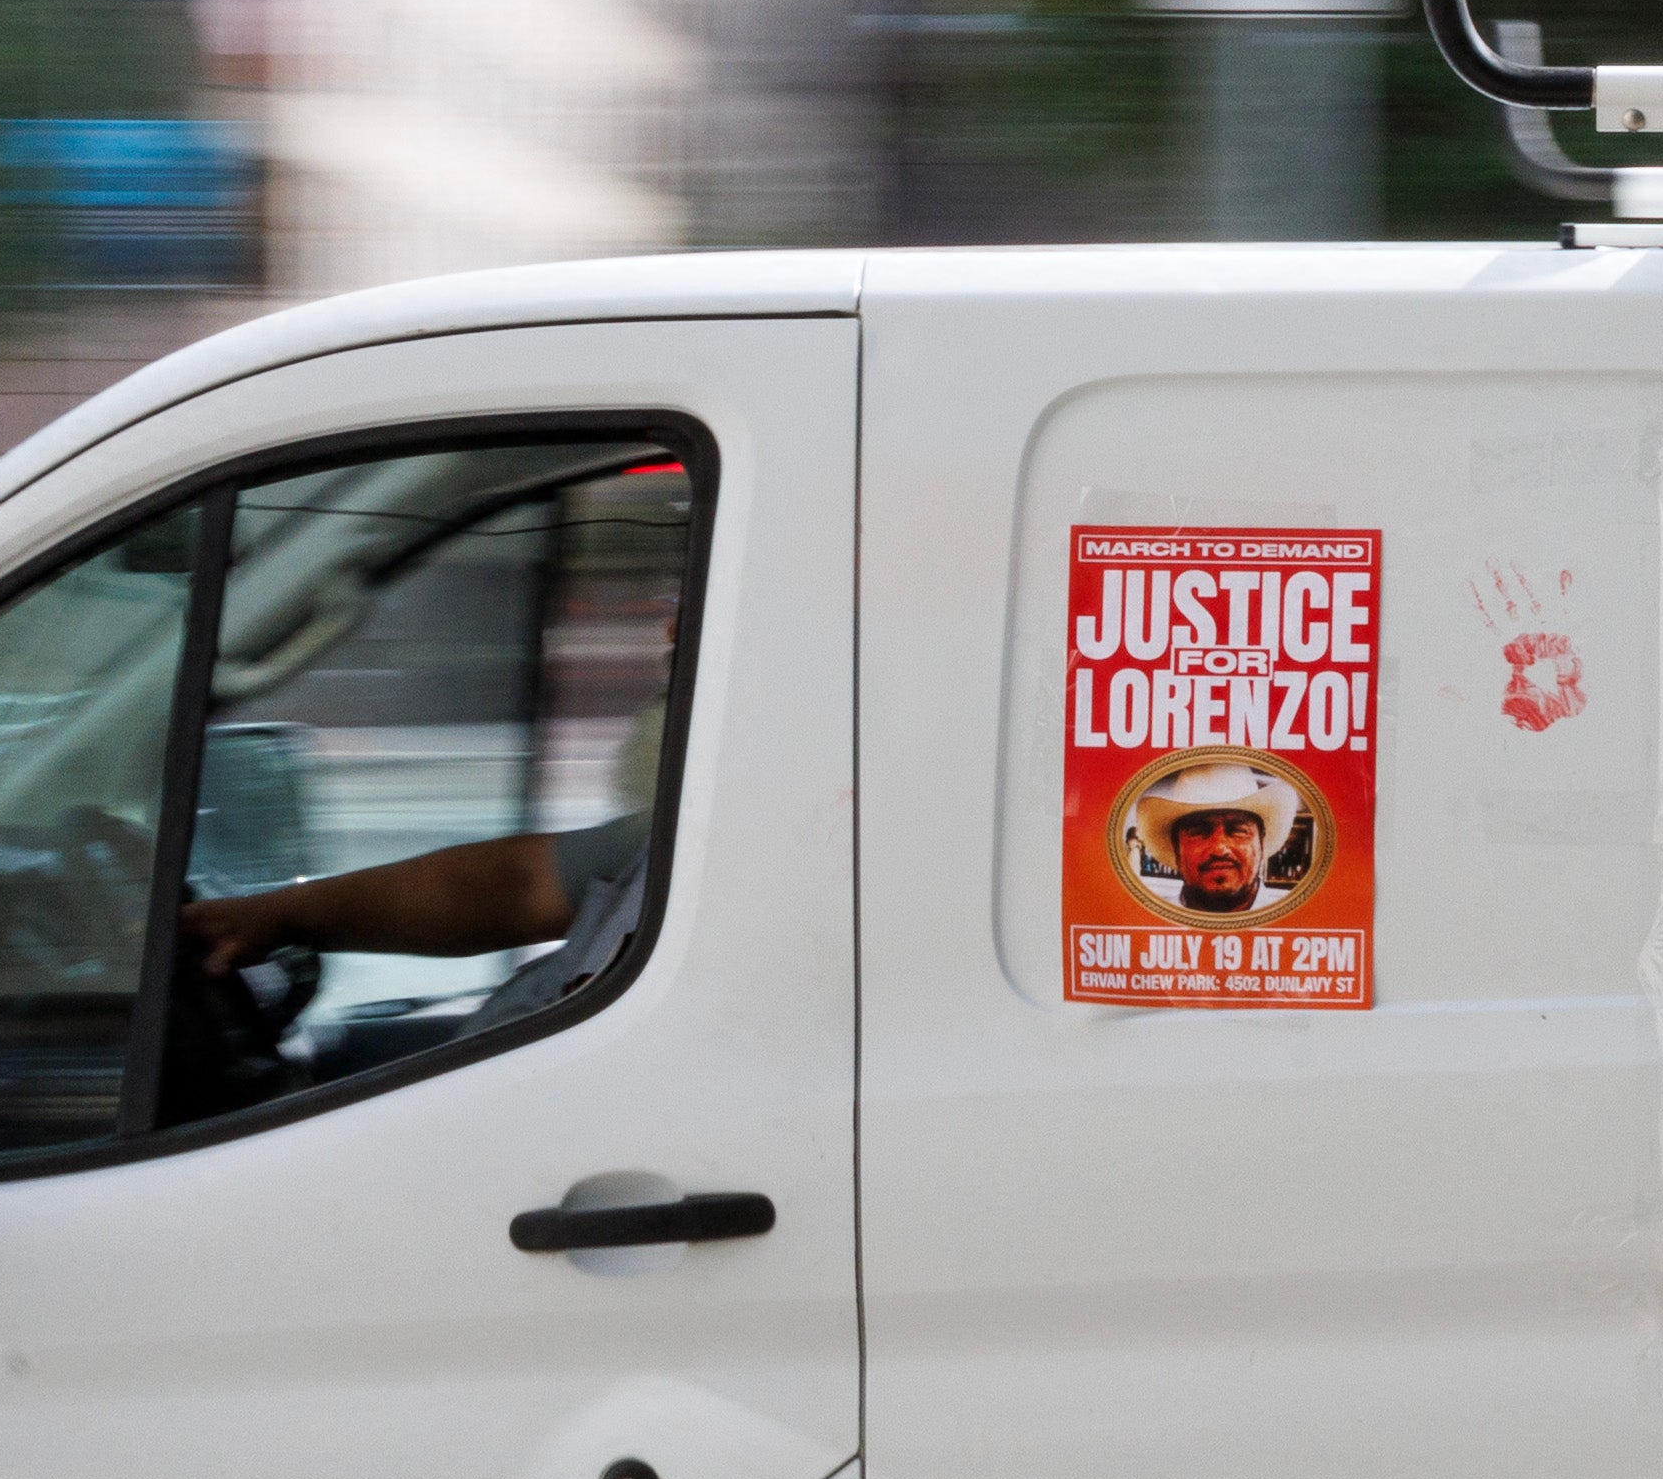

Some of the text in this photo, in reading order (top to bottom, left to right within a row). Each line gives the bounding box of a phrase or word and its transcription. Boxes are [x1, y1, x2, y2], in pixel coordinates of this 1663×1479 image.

[1086, 540, 1364, 560] MARCH TO DEMAND
[1076, 569, 1371, 663] JUSTICE
[1178, 650, 1269, 675] FOR
[1074, 668, 1368, 752] LORENZO!
[1079, 933, 1355, 972] SUN JULY 19 AT 2PM
[1081, 972, 1355, 993] ERVAN CHEW PARK: 4502 DUNLAVY ST
